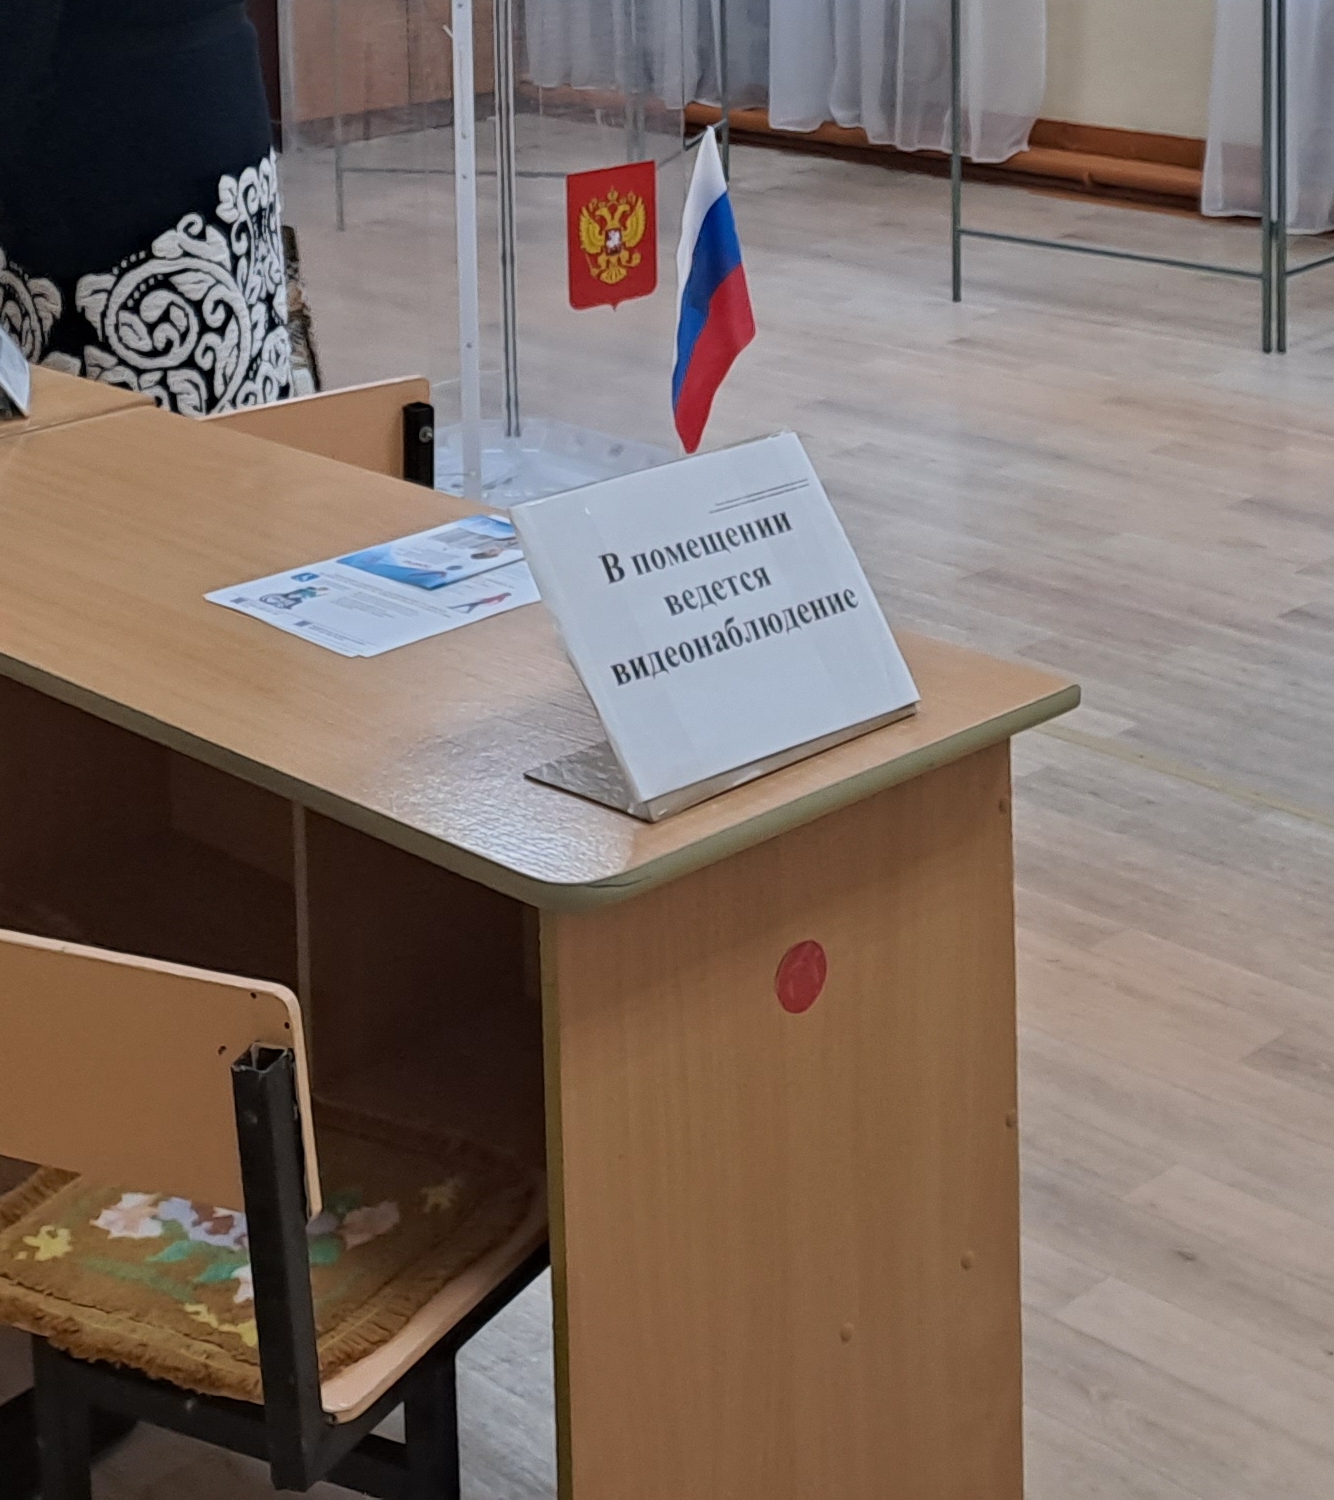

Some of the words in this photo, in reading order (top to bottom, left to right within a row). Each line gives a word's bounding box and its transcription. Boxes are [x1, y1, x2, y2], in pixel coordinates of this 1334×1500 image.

[598, 552, 625, 584] В
[630, 511, 793, 576] помещении
[663, 566, 772, 616] ведется
[610, 588, 859, 687] видеонаблюдение
